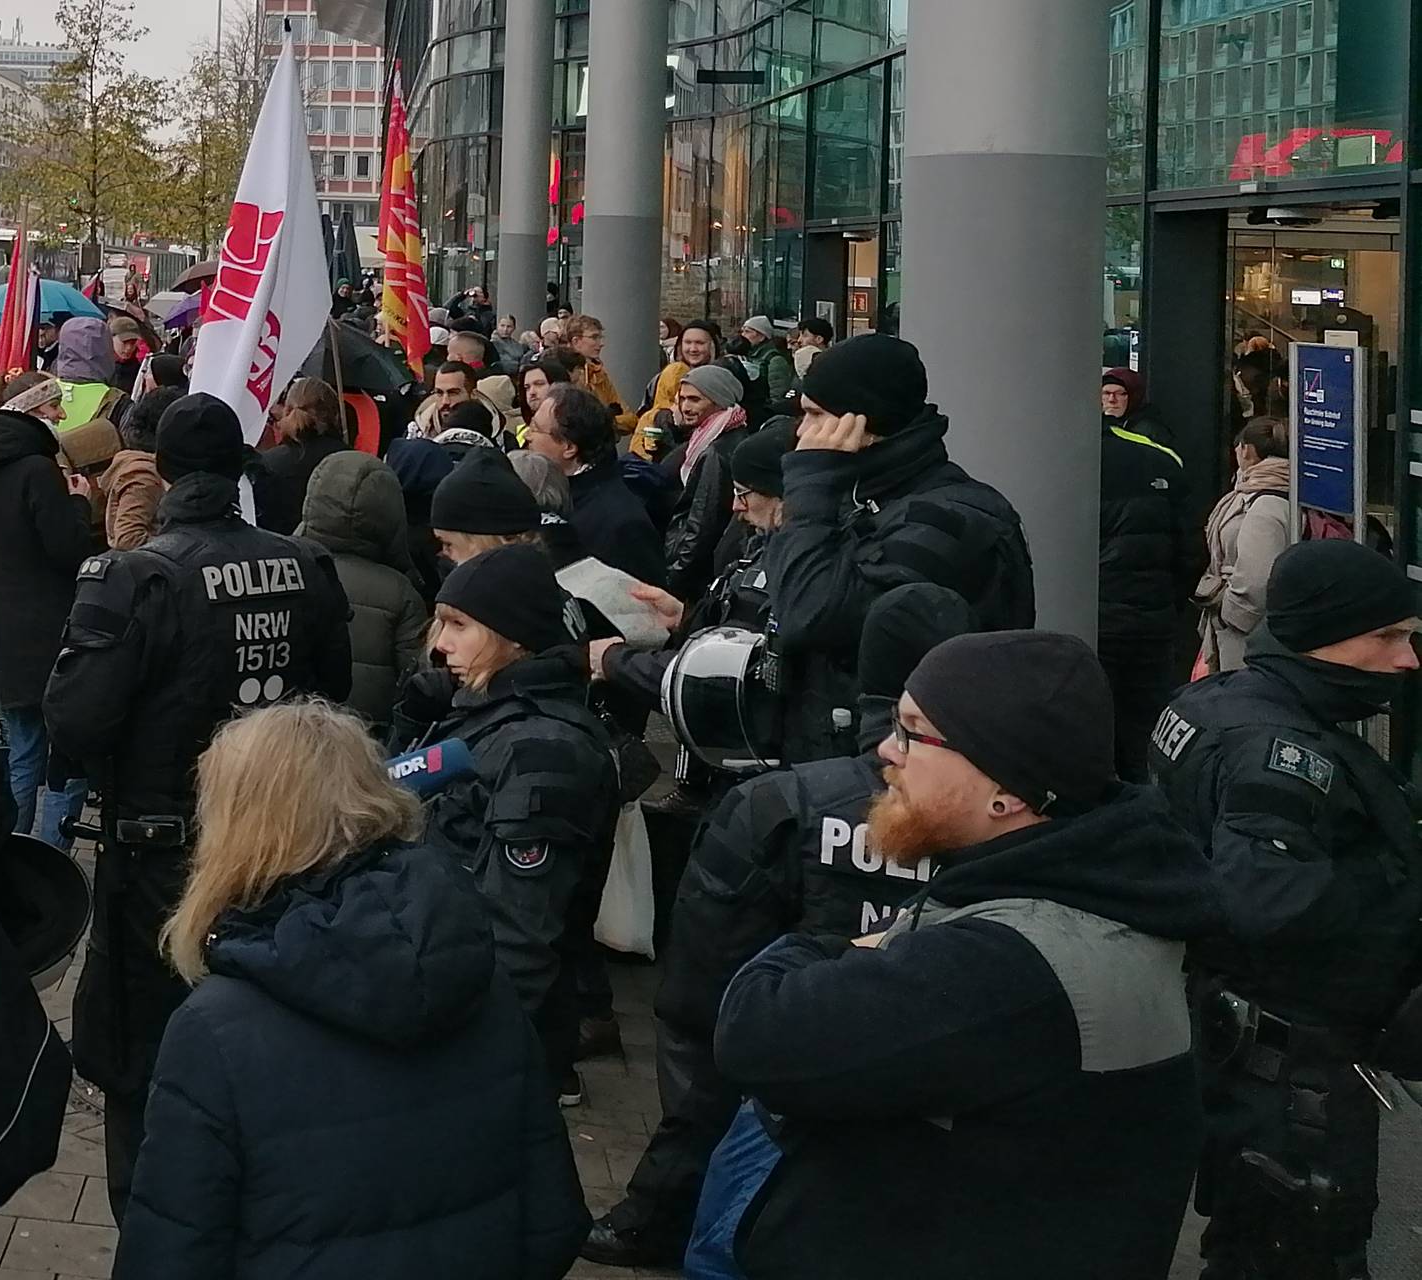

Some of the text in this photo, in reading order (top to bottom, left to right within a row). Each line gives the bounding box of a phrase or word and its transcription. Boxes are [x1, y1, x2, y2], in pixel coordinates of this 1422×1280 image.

[202, 557, 305, 600] POLIZEI
[235, 610, 291, 640] NRW
[235, 641, 291, 672] 1513
